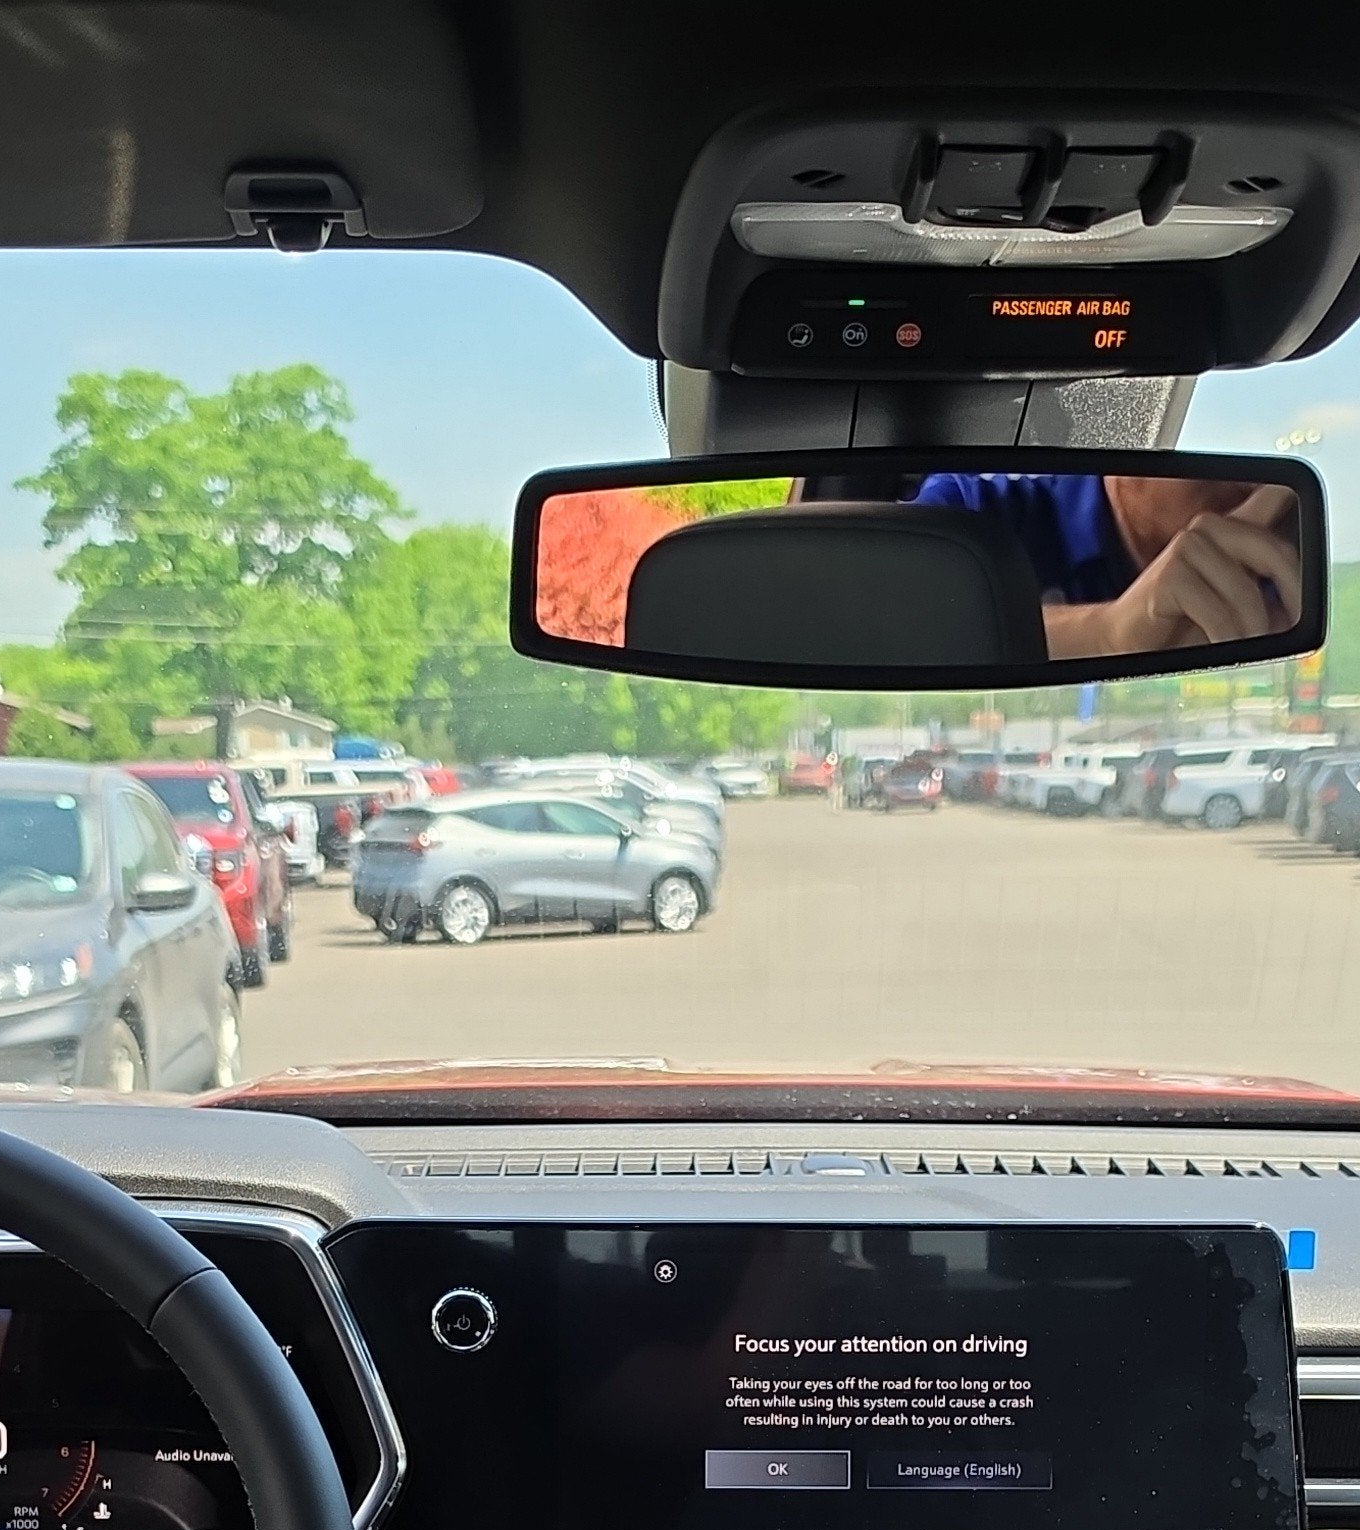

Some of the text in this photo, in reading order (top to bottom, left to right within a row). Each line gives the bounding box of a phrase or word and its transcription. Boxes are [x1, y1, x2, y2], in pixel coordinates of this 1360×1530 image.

[992, 300, 1131, 316] PASSENGER AIR BAG
[898, 328, 919, 341] SOS
[1094, 330, 1127, 348] OFF
[735, 1335, 1028, 1357] Focus your attention on driving
[729, 1377, 1031, 1392] Taking your eyes off the road for too long or too
[726, 1396, 1033, 1411] often while using this system could cause a crash
[744, 1414, 1014, 1428] resulting in injury or death to you or others.
[61, 1447, 69, 1457] 6
[155, 1450, 234, 1461] Audio Unava
[767, 1463, 788, 1476] OK
[897, 1463, 1022, 1479] Language (English)
[103, 1480, 112, 1490] H
[41, 1488, 49, 1498] 7
[14, 1506, 39, 1516] RPM
[6, 1520, 39, 1530] x1000
